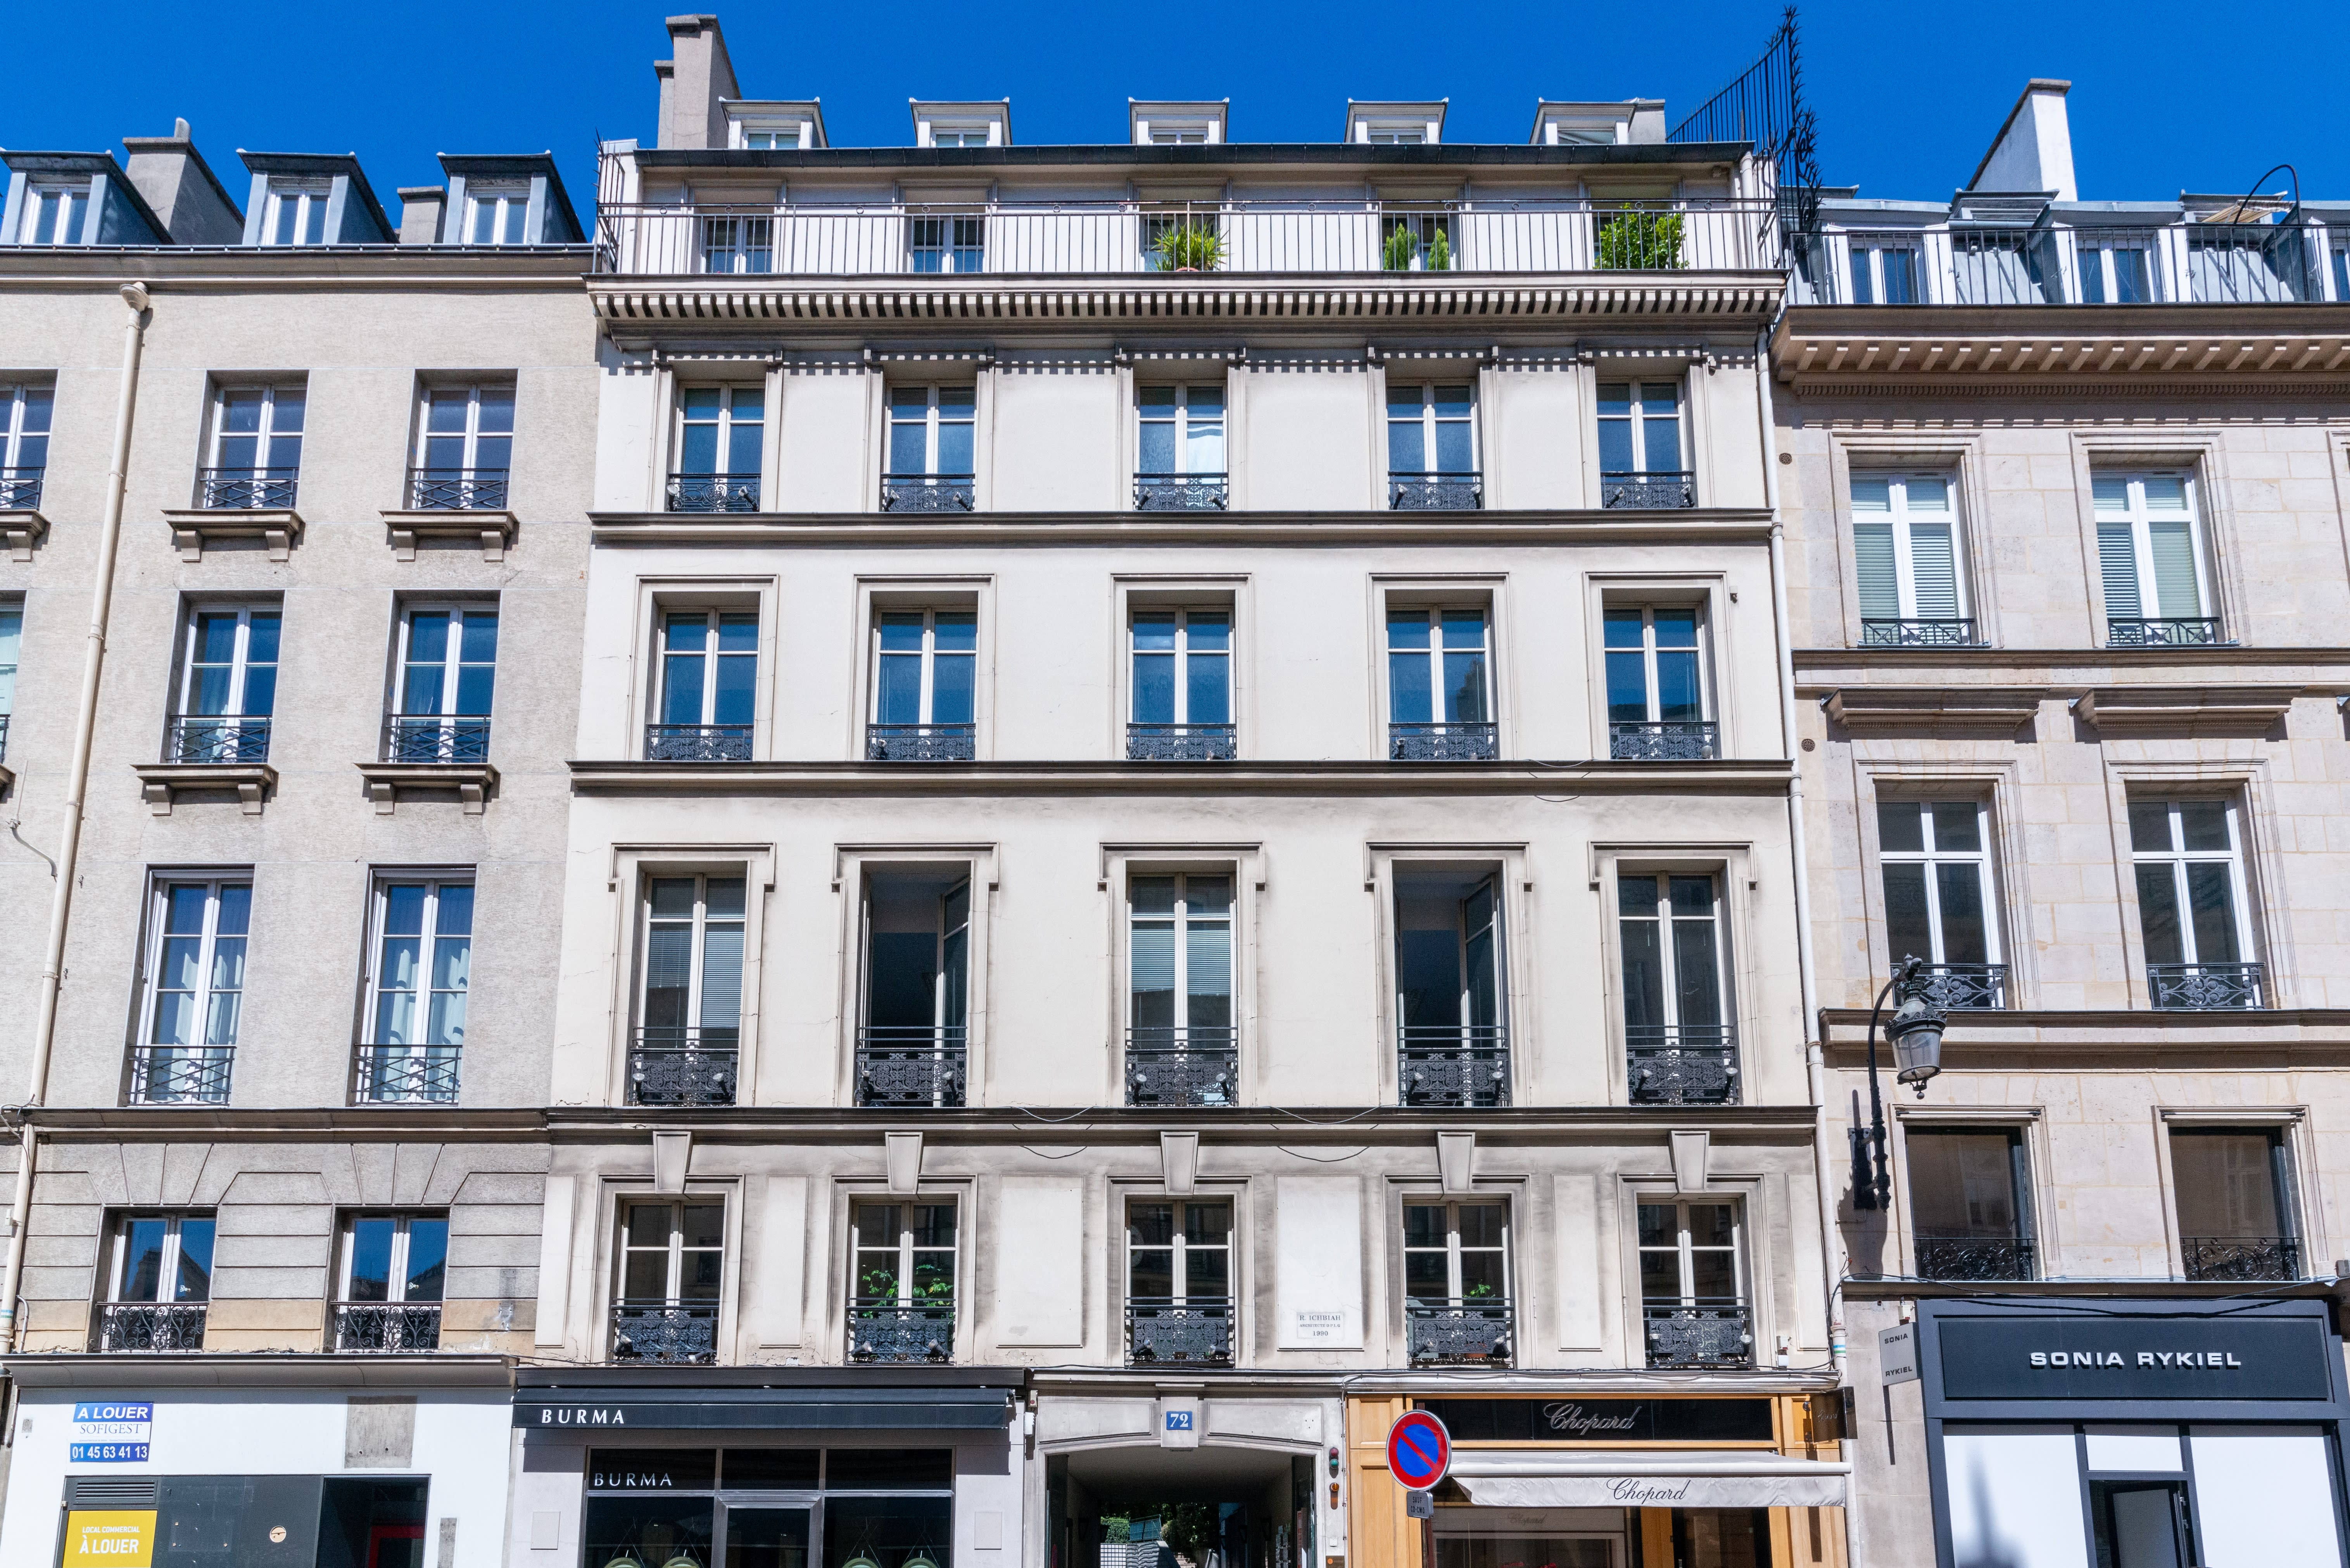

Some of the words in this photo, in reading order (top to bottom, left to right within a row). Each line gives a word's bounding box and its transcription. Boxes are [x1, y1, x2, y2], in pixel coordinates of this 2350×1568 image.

[1884, 1333, 1908, 1344] SONIA
[2030, 1352, 2125, 1365] SONIA
[2137, 1352, 2241, 1366] RYKIEL
[1886, 1366, 1913, 1377] RYKIEL
[78, 1407, 89, 1419] A
[93, 1407, 148, 1419] LOUER
[541, 1409, 625, 1424] BURMA
[1543, 1402, 1642, 1435] Chopard
[1170, 1413, 1188, 1427] 72
[79, 1423, 142, 1434] SOFIGEST
[72, 1446, 84, 1458] 01
[87, 1446, 100, 1458] 45
[103, 1446, 116, 1458] 63
[118, 1446, 131, 1458] 41
[135, 1446, 148, 1458] 13
[594, 1473, 672, 1486] BURMA
[1606, 1478, 1691, 1504] Chopard
[79, 1535, 89, 1554] À
[92, 1539, 139, 1554] LOUER
